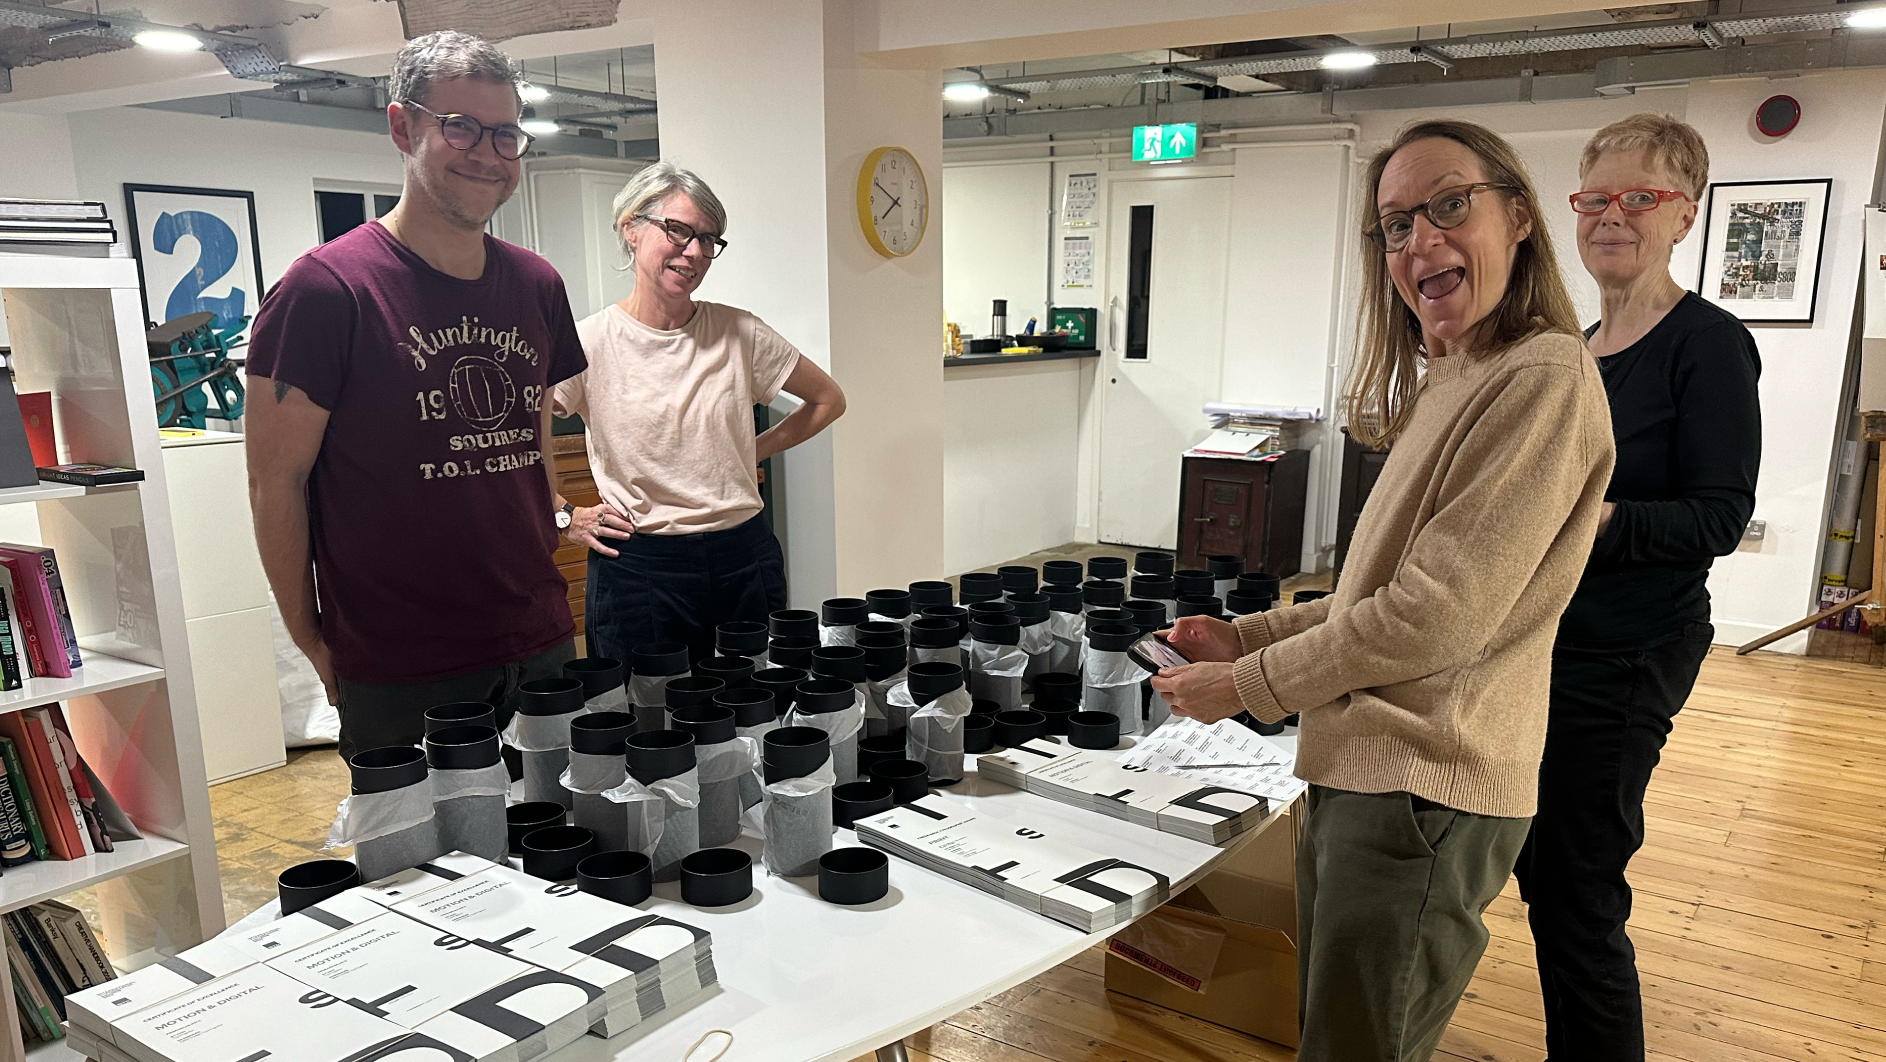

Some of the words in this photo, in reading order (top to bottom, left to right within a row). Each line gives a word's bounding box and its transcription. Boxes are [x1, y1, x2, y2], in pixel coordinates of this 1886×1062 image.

[882, 163, 886, 173] 11
[891, 160, 896, 170] 12
[874, 216, 878, 226] 8
[153, 211, 245, 329] 2
[397, 315, 539, 371] Huntington
[416, 389, 447, 421] 19
[523, 385, 542, 413] 82
[450, 428, 534, 451] SQUIRES
[0, 774, 25, 835] DICTIONARY
[429, 897, 468, 914] MOTION
[476, 881, 512, 896] DIGITAL
[44, 917, 59, 940] Banksy
[306, 950, 350, 970] MOTION
[360, 930, 400, 948] DIGITAL
[155, 1007, 207, 1031] MOTION
[216, 984, 265, 1006] DIGITAL
